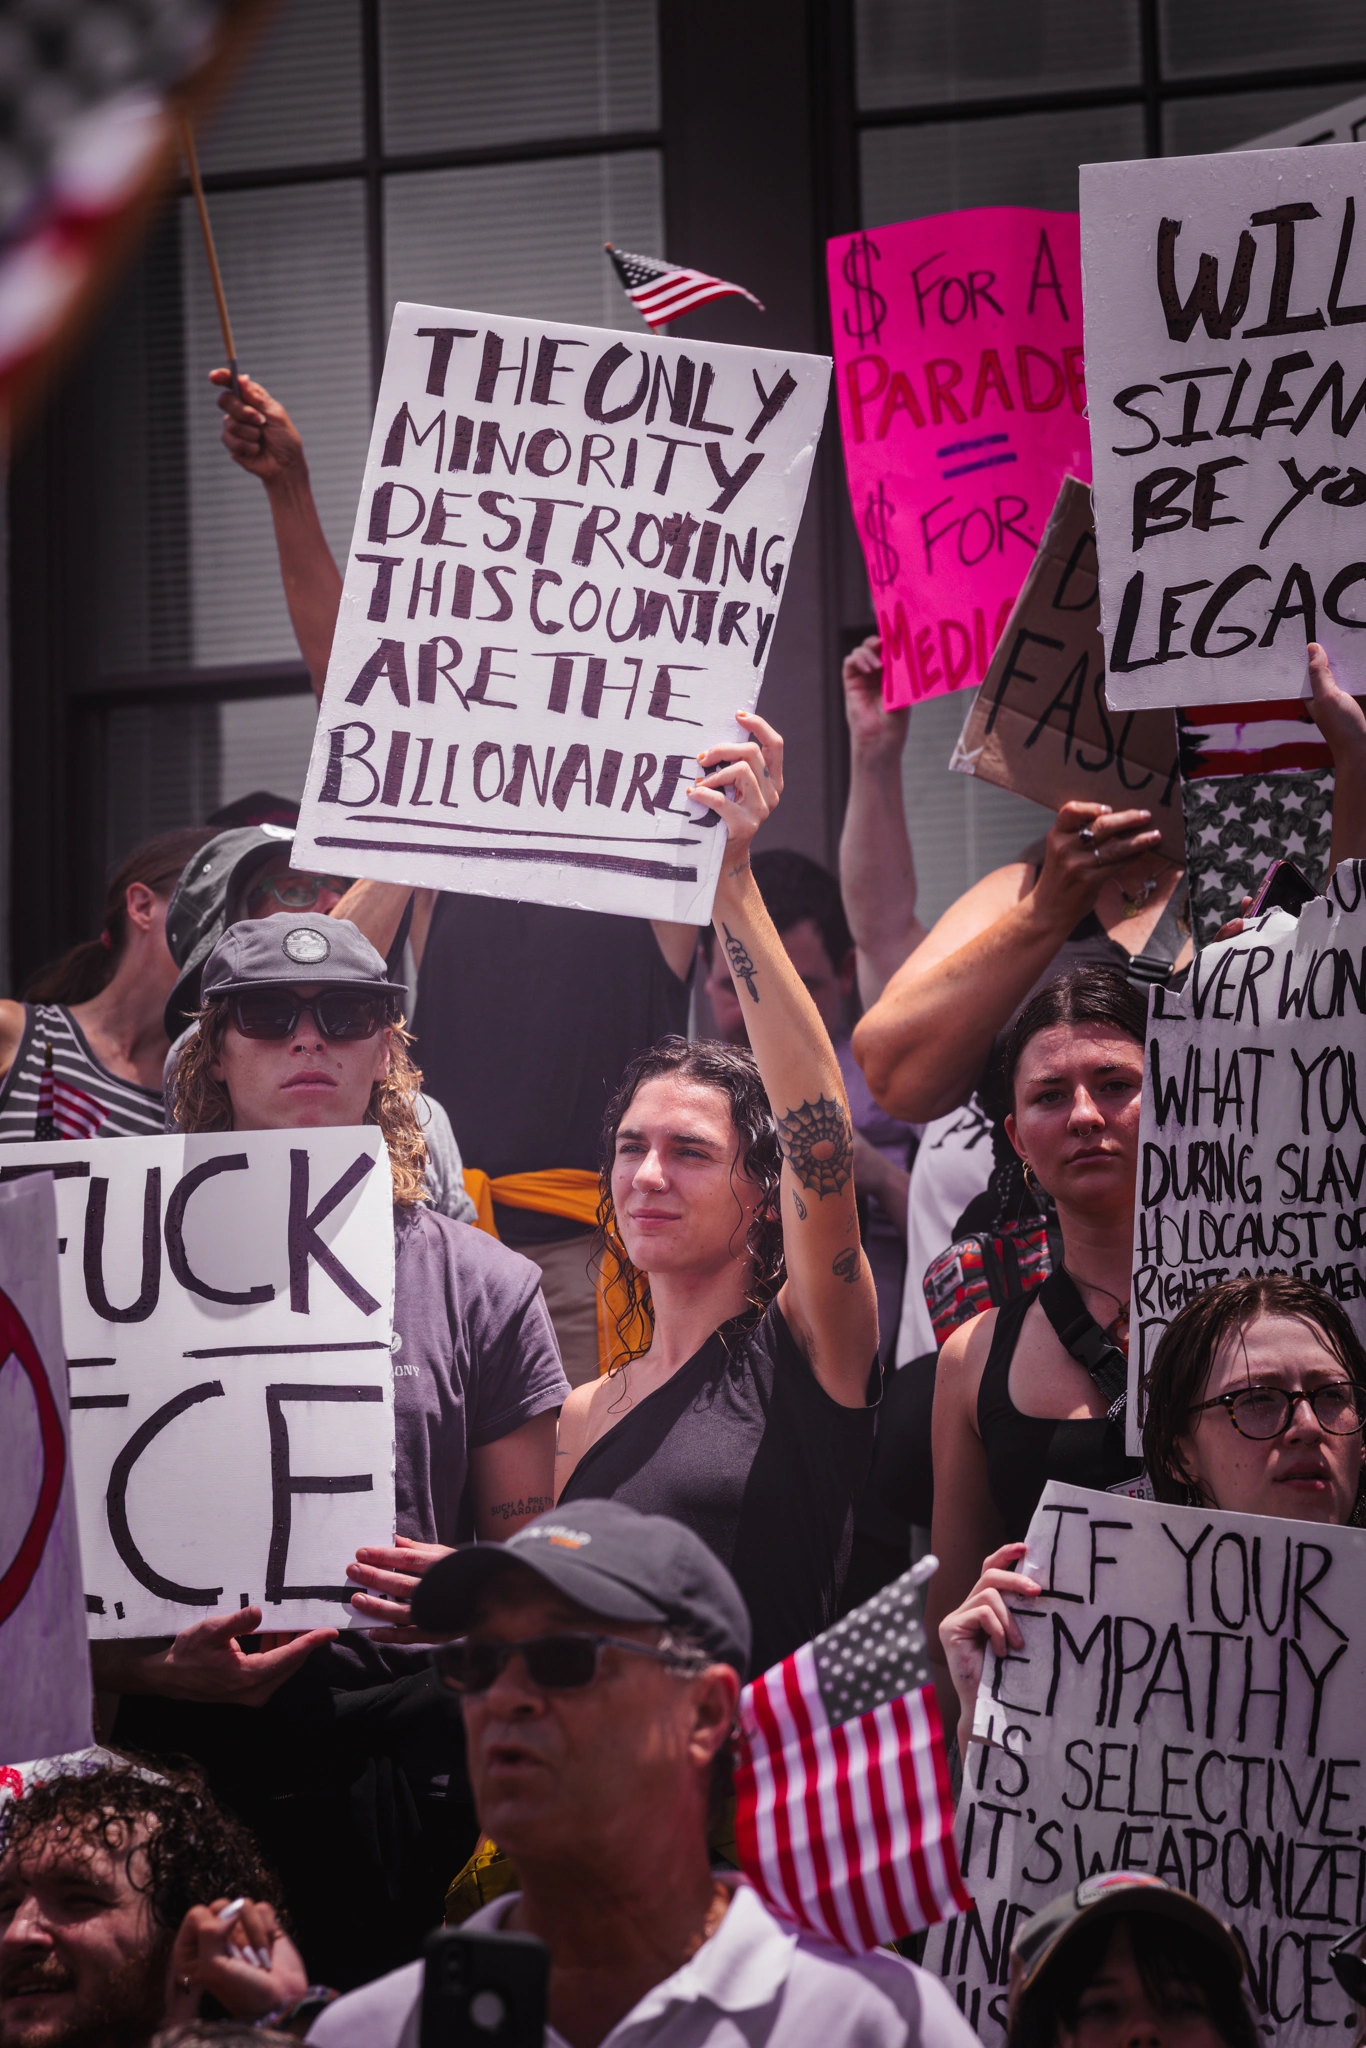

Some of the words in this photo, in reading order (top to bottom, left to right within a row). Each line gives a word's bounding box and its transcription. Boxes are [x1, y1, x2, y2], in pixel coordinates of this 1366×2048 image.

[843, 232, 887, 350] $
[911, 251, 1004, 329] FOR
[1027, 226, 1070, 322] A
[414, 327, 590, 406] THE
[584, 342, 797, 444] ONLY
[381, 402, 765, 513] MINORITY
[1132, 456, 1249, 552] BE
[367, 482, 785, 596] DESTROYING
[863, 480, 899, 592] $
[355, 554, 517, 622] THIS
[528, 568, 775, 667] COUNTRY
[345, 636, 518, 712] ARE
[531, 650, 709, 727] THE
[1150, 1038, 1275, 1136] WHAT
[1142, 1134, 1262, 1208] DURING
[1136, 1206, 1327, 1267] HOLOCAUST
[491, 1502, 514, 1516] SUCH
[517, 1499, 525, 1507] A
[503, 1505, 545, 1519] GARDEN
[1039, 1504, 1133, 1605] IF
[1161, 1522, 1349, 1643] YOUR
[991, 1606, 1348, 1757] EMPATHY
[976, 1716, 1032, 1798] IS
[960, 1801, 1063, 1884] IT'S
